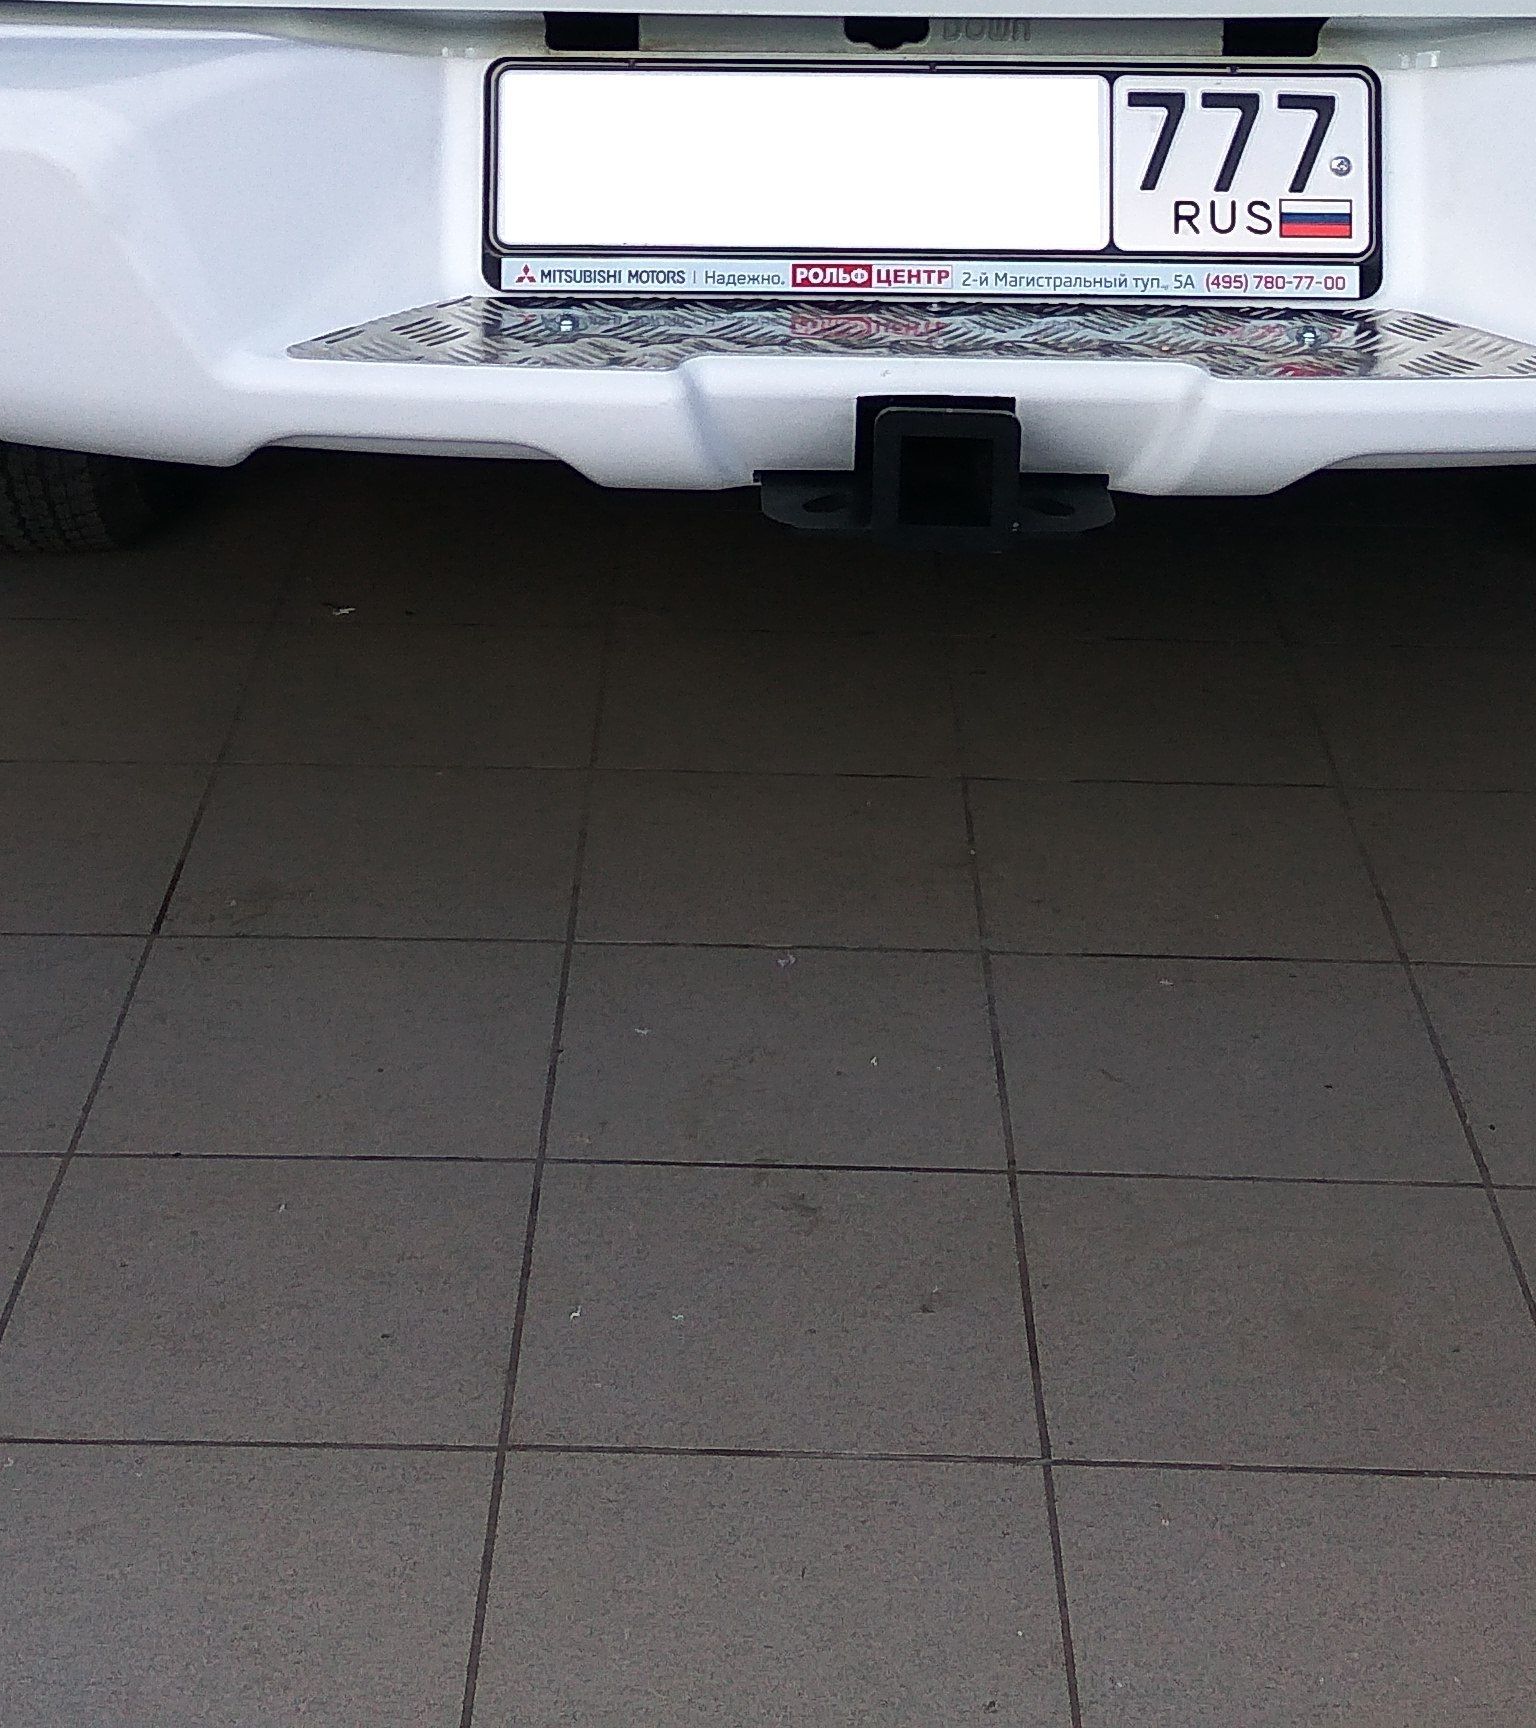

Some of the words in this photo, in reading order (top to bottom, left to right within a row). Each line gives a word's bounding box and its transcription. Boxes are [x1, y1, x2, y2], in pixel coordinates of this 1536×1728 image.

[1127, 91, 1337, 193] 777
[1173, 199, 1273, 235] RUS
[540, 269, 622, 284] MITSUBISHI
[627, 270, 686, 284] MOTORS
[704, 271, 785, 286] Надежно.
[796, 267, 869, 285] РОЛЬФ
[876, 269, 950, 287] ЦЕНТР
[962, 272, 989, 287] 2-й
[994, 273, 1128, 291] Магистральный
[1205, 273, 1249, 292] (495)
[1253, 275, 1346, 291] 780-77-00
